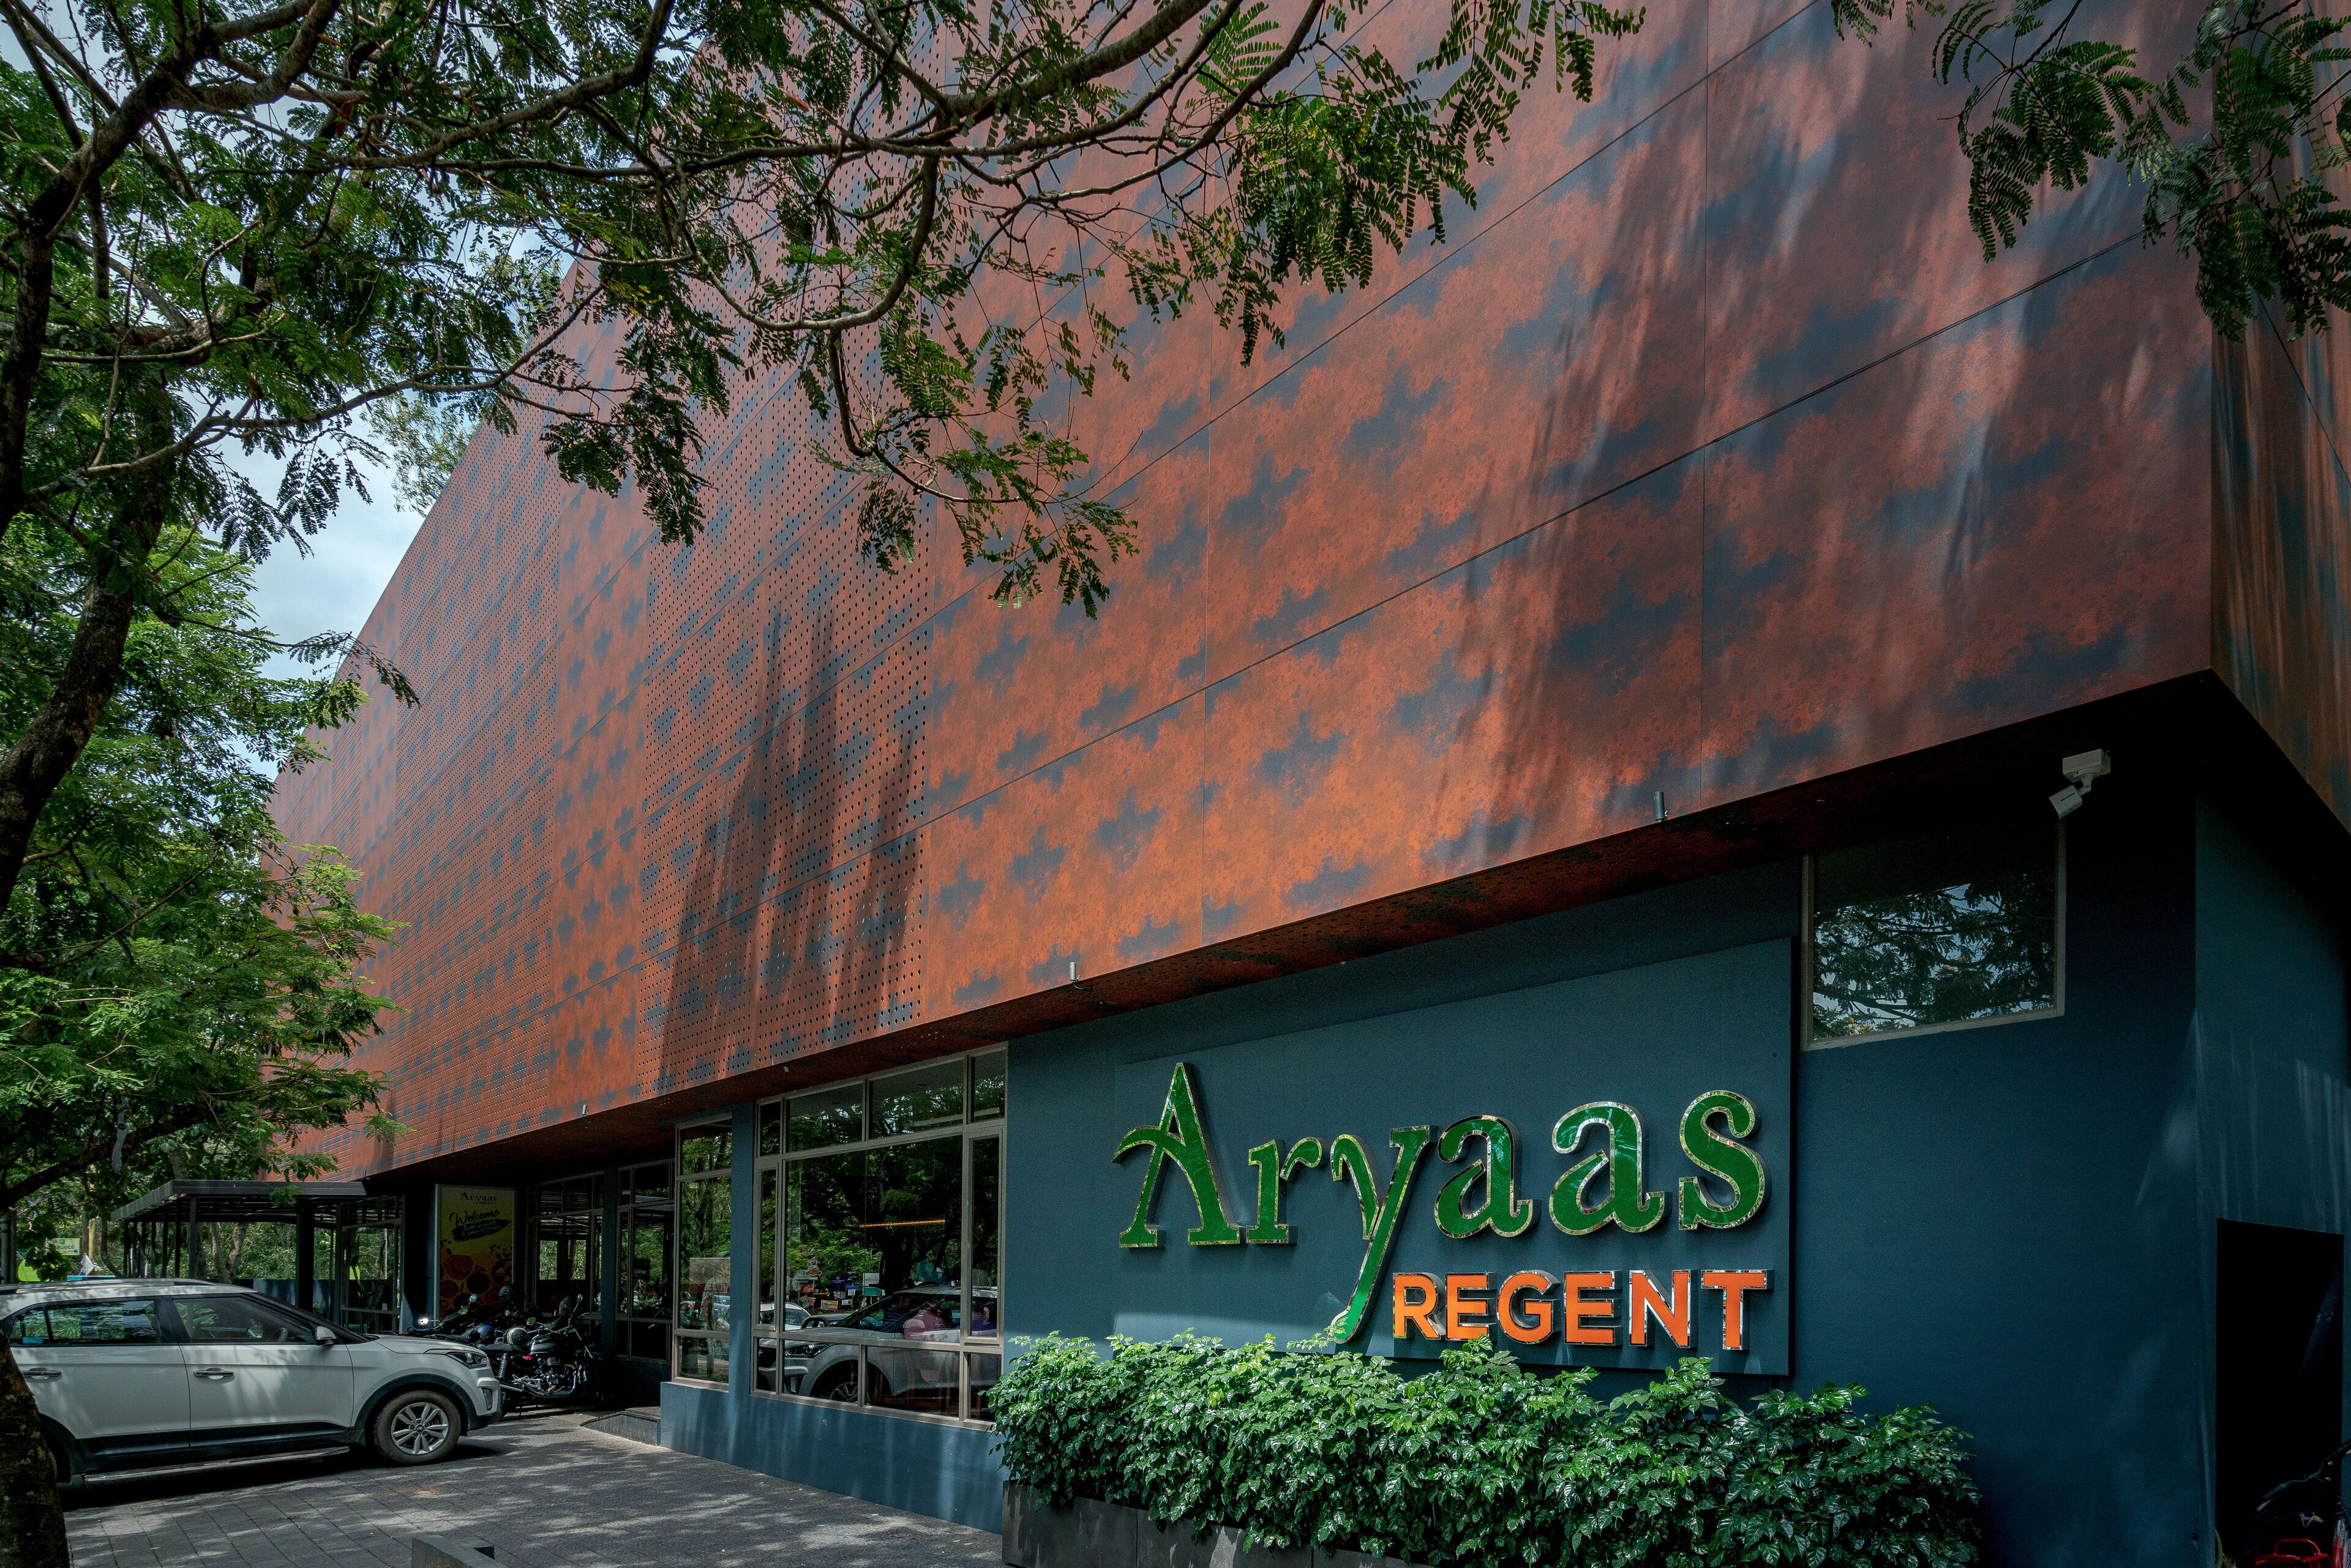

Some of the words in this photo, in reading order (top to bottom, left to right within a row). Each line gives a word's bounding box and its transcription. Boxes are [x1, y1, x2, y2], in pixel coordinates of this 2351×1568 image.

[449, 1210, 500, 1228] Welcome
[460, 1191, 497, 1205] Aryaas
[1111, 1062, 1771, 1344] Aryaas
[1392, 1269, 1773, 1351] REGENT
